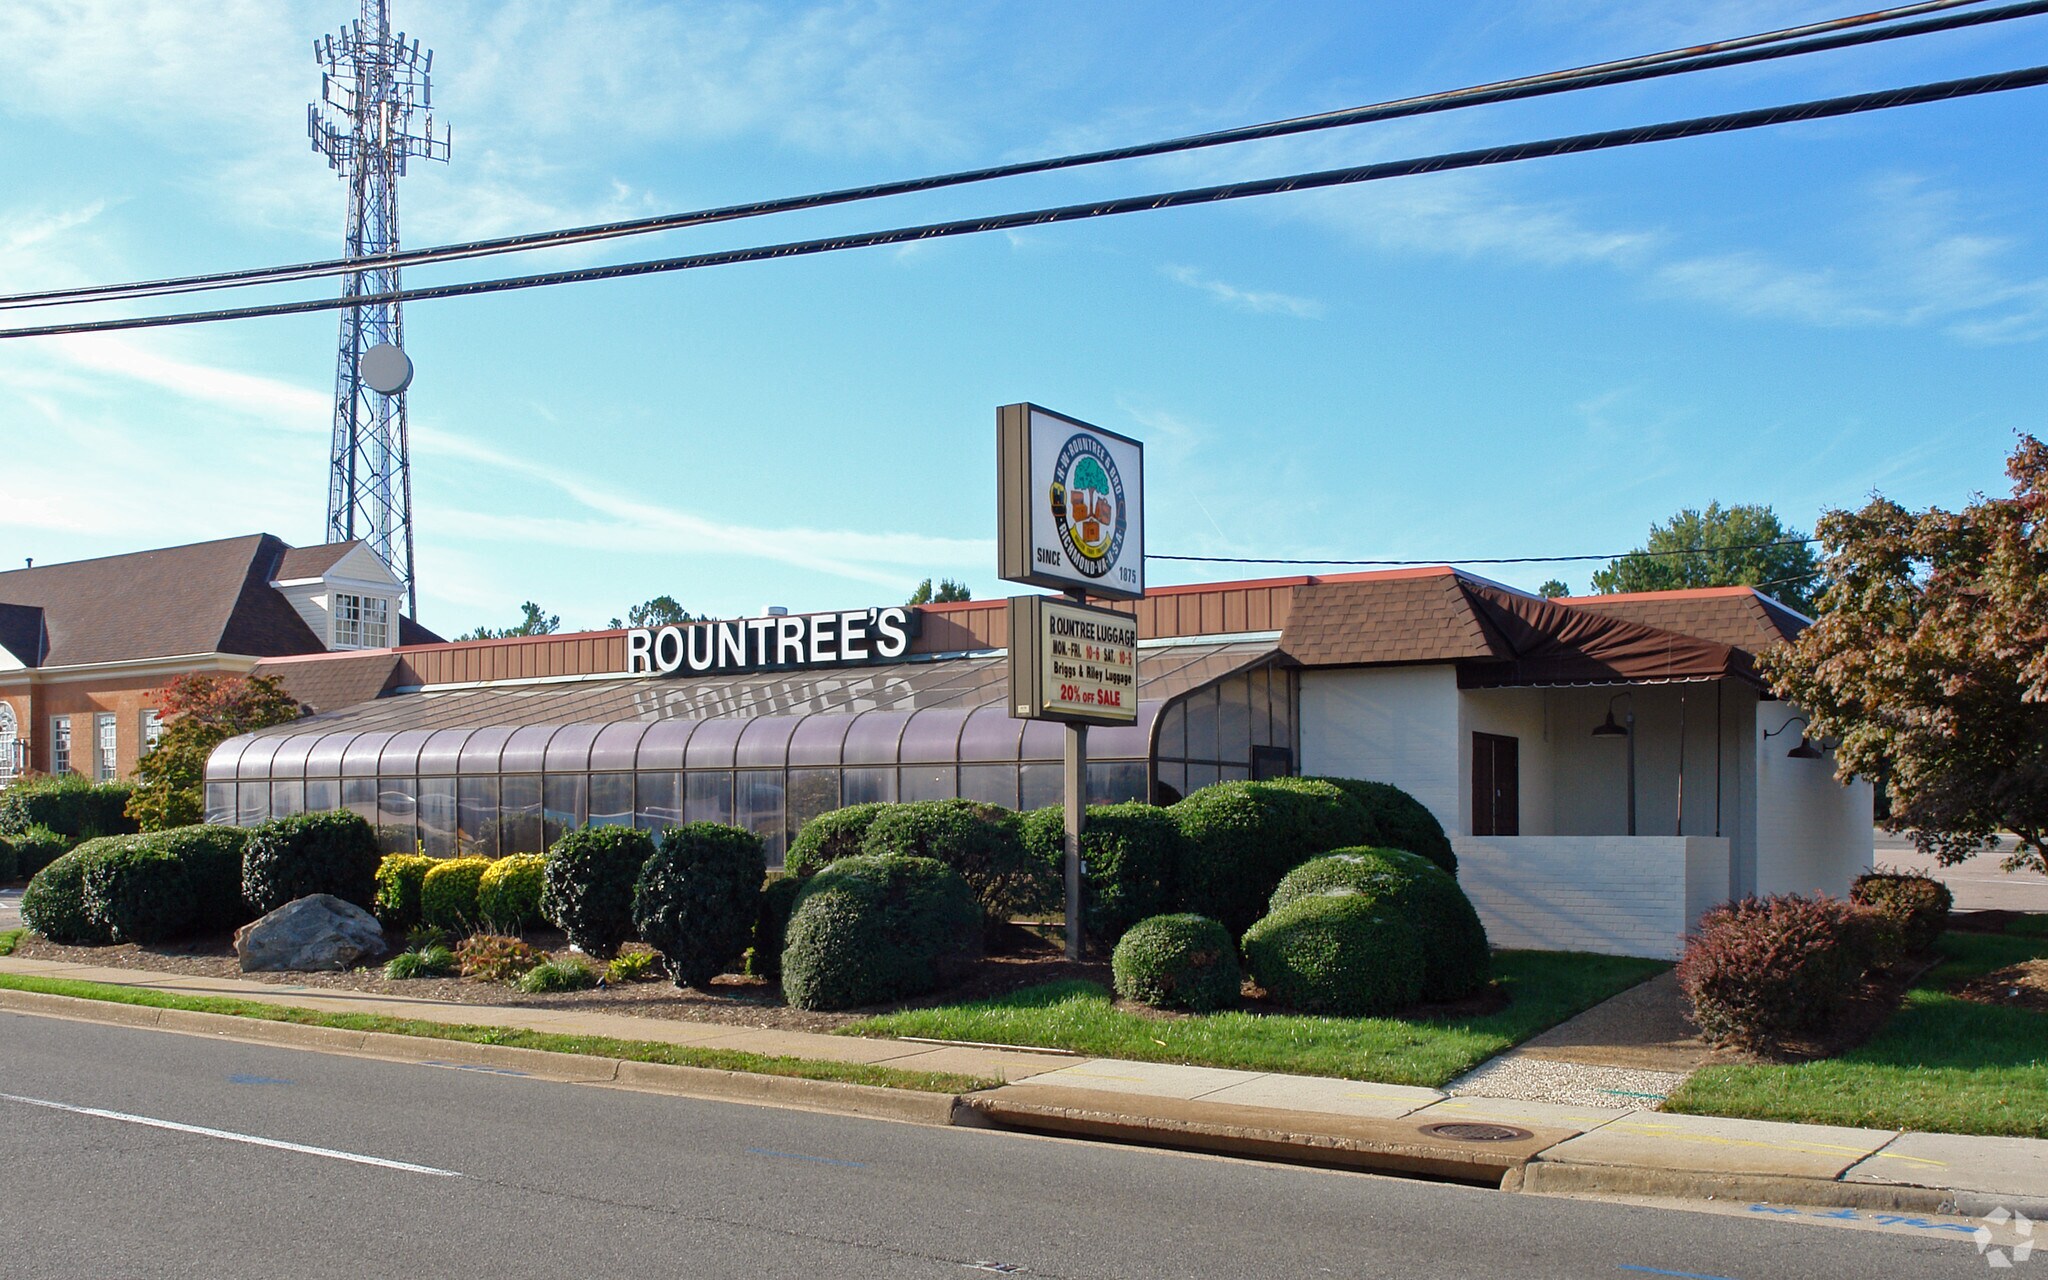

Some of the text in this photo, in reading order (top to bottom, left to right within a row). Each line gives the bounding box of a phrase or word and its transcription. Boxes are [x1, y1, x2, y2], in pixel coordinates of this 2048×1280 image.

[1037, 547, 1061, 567] SINCE
[1058, 522, 1097, 575] RICHMOND
[1119, 566, 1137, 584] 1875
[627, 607, 908, 674] ROUNTREE'S
[1050, 615, 1135, 648] ROUNTREE LUGGAGE
[1104, 648, 1116, 663] SAT.
[1054, 661, 1132, 686] Briggs & Riley Luggage
[1060, 684, 1121, 706] 20% OFF SALE
